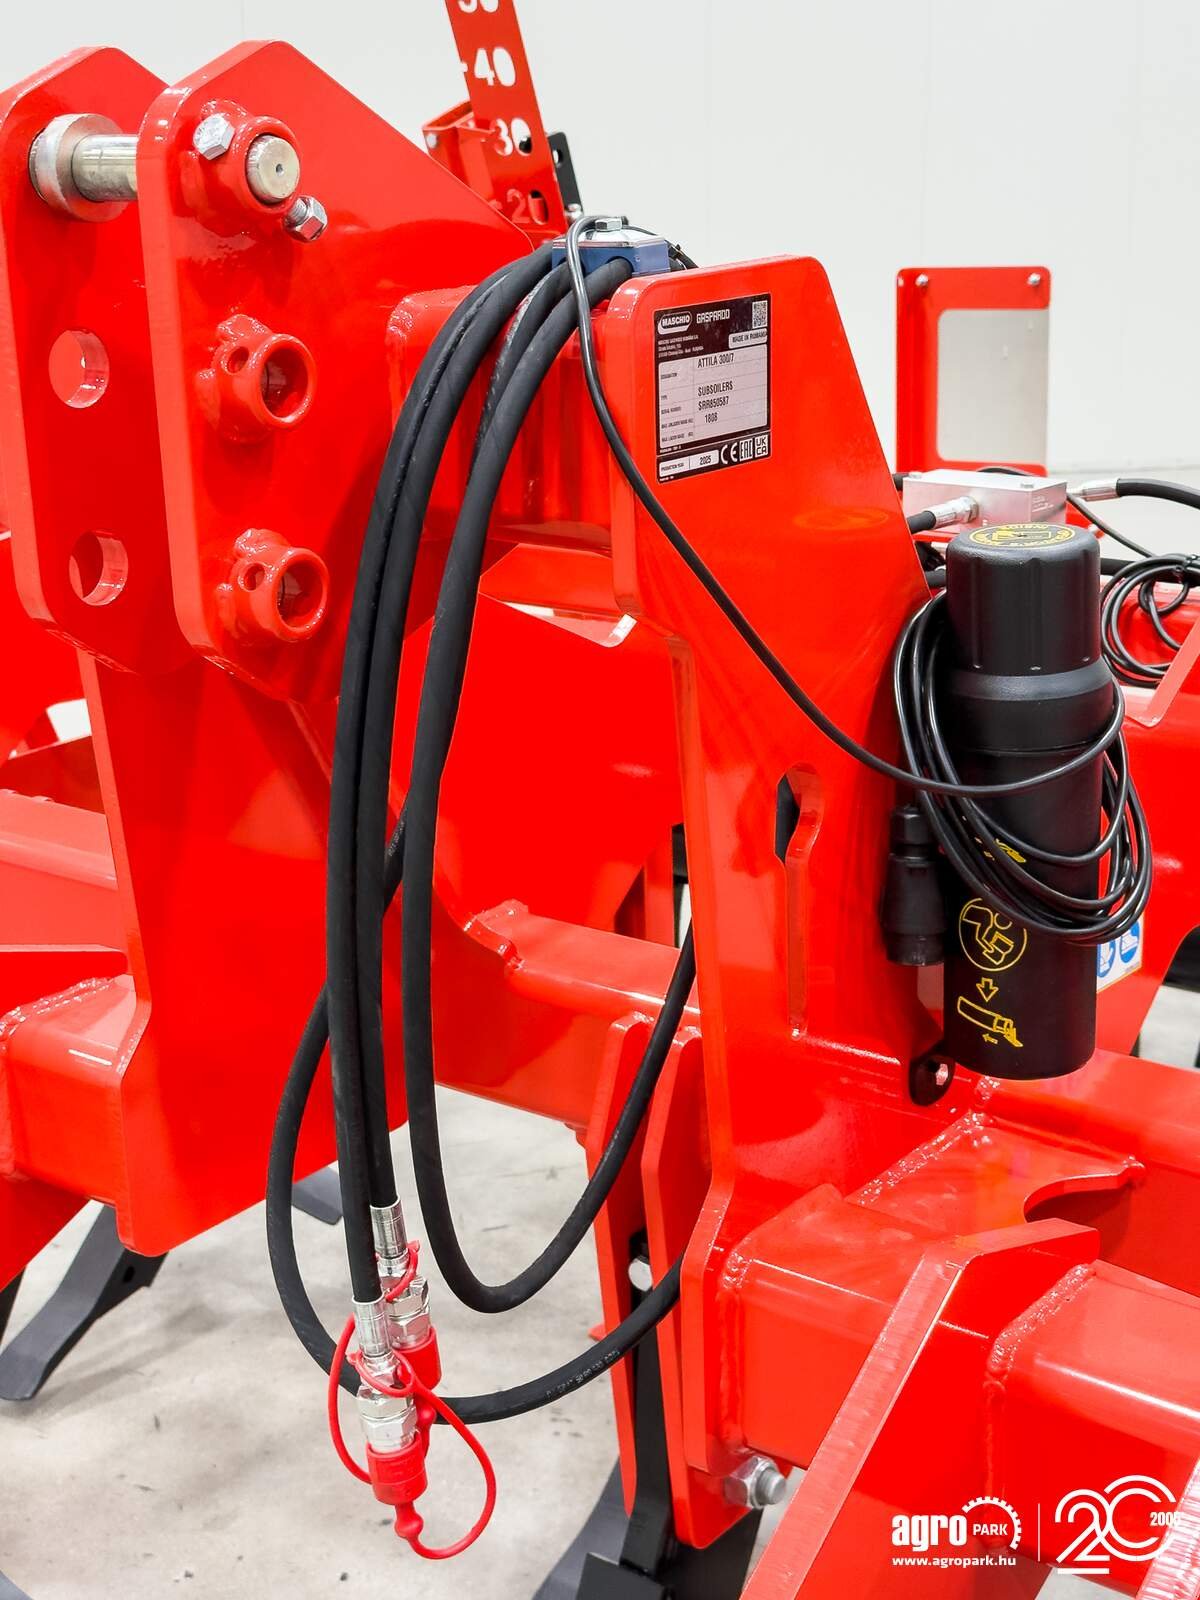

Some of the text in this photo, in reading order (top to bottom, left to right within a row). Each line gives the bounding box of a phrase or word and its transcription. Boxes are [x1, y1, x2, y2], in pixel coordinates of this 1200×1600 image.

[474, 47, 516, 87] 40
[489, 117, 533, 156] 30
[506, 188, 549, 225] 20
[662, 309, 730, 327] MASCHIO GASPARDO
[732, 335, 744, 343] MADE
[697, 356, 718, 369] ATTILA
[697, 381, 734, 397] SUBSOILERS
[704, 412, 718, 424] 1808
[700, 455, 712, 466] 2025
